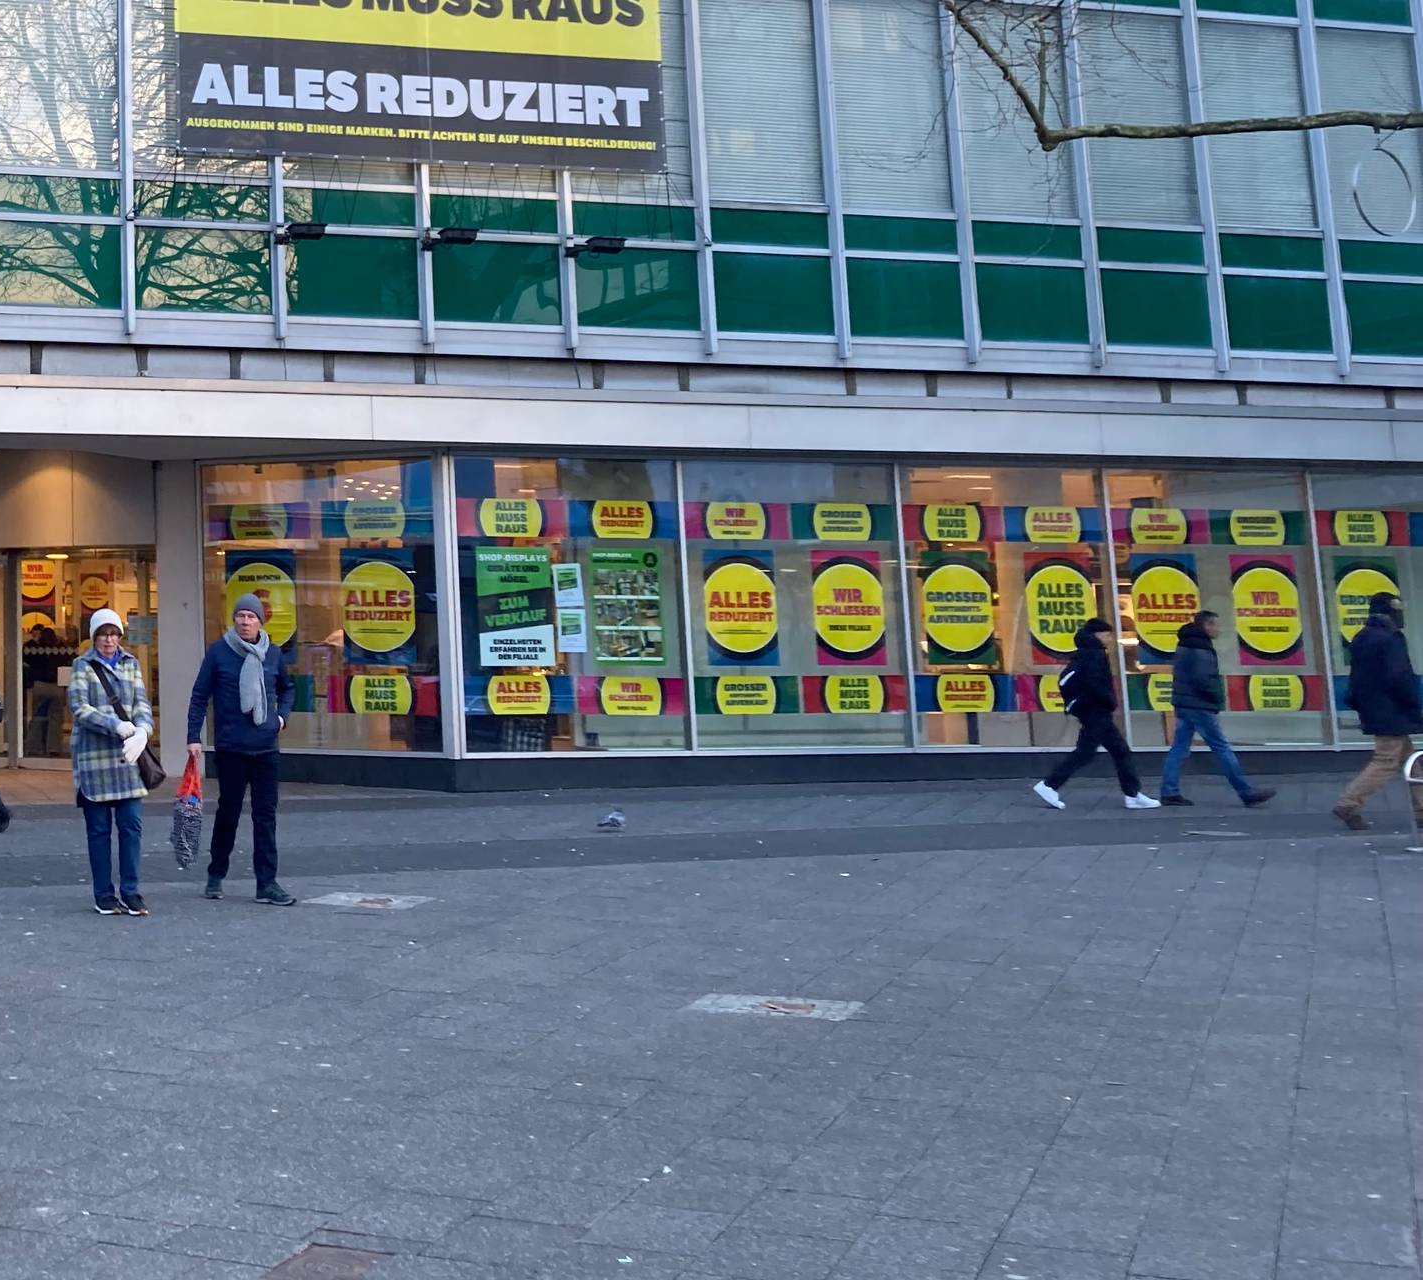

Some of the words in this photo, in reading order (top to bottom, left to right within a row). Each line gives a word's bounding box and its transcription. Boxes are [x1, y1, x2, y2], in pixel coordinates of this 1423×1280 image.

[191, 62, 358, 113] ALLES
[365, 73, 649, 127] REDUZIERT
[186, 117, 274, 131] AUSGENOMMEN
[277, 122, 304, 133] SIND
[306, 123, 343, 135] EINIGE
[345, 126, 396, 137] MARKEN.
[398, 128, 430, 140] BITTE
[432, 130, 476, 142] ACHTEN
[478, 133, 496, 144] SIE
[498, 134, 520, 144] AUF
[522, 135, 564, 146] UNSERE
[565, 138, 656, 151] BESCHILDERUNG!
[495, 501, 527, 510] ALLES
[495, 512, 528, 521] MUSS
[600, 506, 644, 518] ALLES
[495, 523, 528, 533] RAUS
[479, 553, 548, 562] SHOP-DISPLAYS
[832, 588, 864, 603] WIR
[1036, 583, 1084, 598] ALLES
[344, 589, 412, 607] ALLES
[709, 591, 773, 608] ALLES
[925, 591, 988, 602] GROSSER
[1137, 592, 1197, 609] ALLES
[1250, 591, 1280, 606] WIR
[498, 595, 529, 610] ZUM
[816, 605, 882, 616] SCHLIESSEN
[1037, 601, 1086, 616] MUSS
[345, 610, 413, 621] REDUZIERT
[484, 608, 547, 627] VERKAUF
[709, 612, 774, 622] REDUZIERT
[365, 678, 397, 688] ALLES
[497, 681, 541, 693] ALLES
[621, 682, 641, 693] WIR
[839, 678, 869, 687] ALLES
[945, 681, 986, 691] ALLES
[365, 690, 397, 700] MUSS
[839, 689, 870, 699] MUSS
[365, 701, 397, 711] RAUS
[839, 700, 871, 710] RAUS
